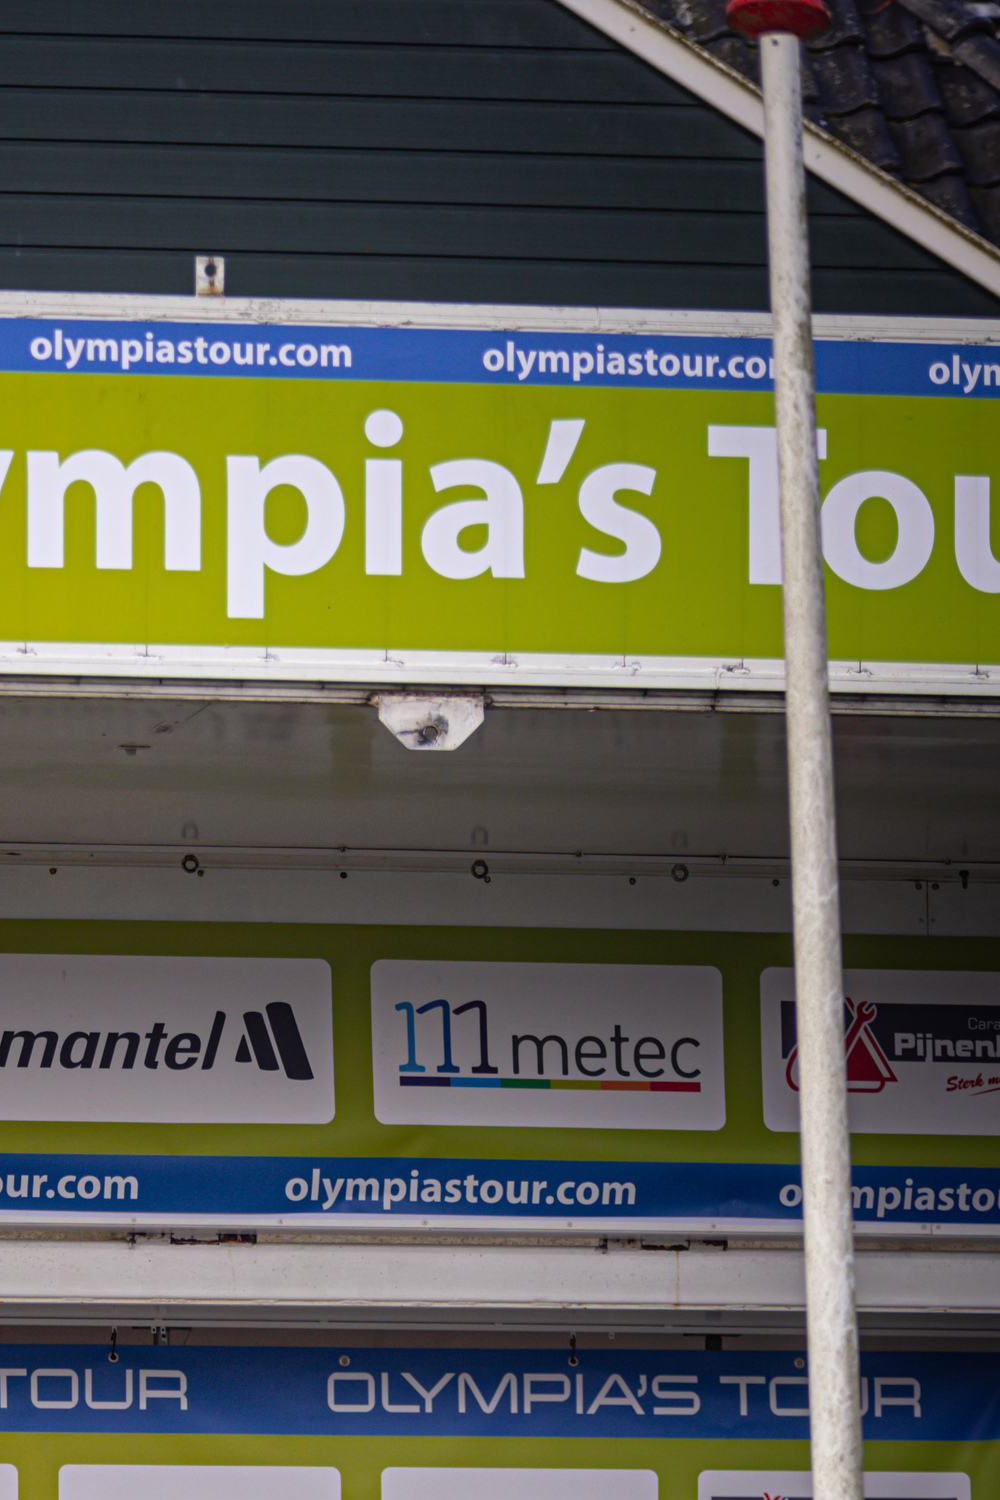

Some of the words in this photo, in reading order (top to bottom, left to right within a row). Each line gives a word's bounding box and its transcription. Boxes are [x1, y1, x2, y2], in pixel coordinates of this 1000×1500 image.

[30, 331, 352, 371] olympiastour.com
[512, 1025, 701, 1079] metec
[285, 1169, 636, 1212] olympiastour.com
[779, 1178, 1000, 1218] ompiasto
[327, 1372, 701, 1416] OLYMPIA'S
[719, 1376, 921, 1417] TOR
